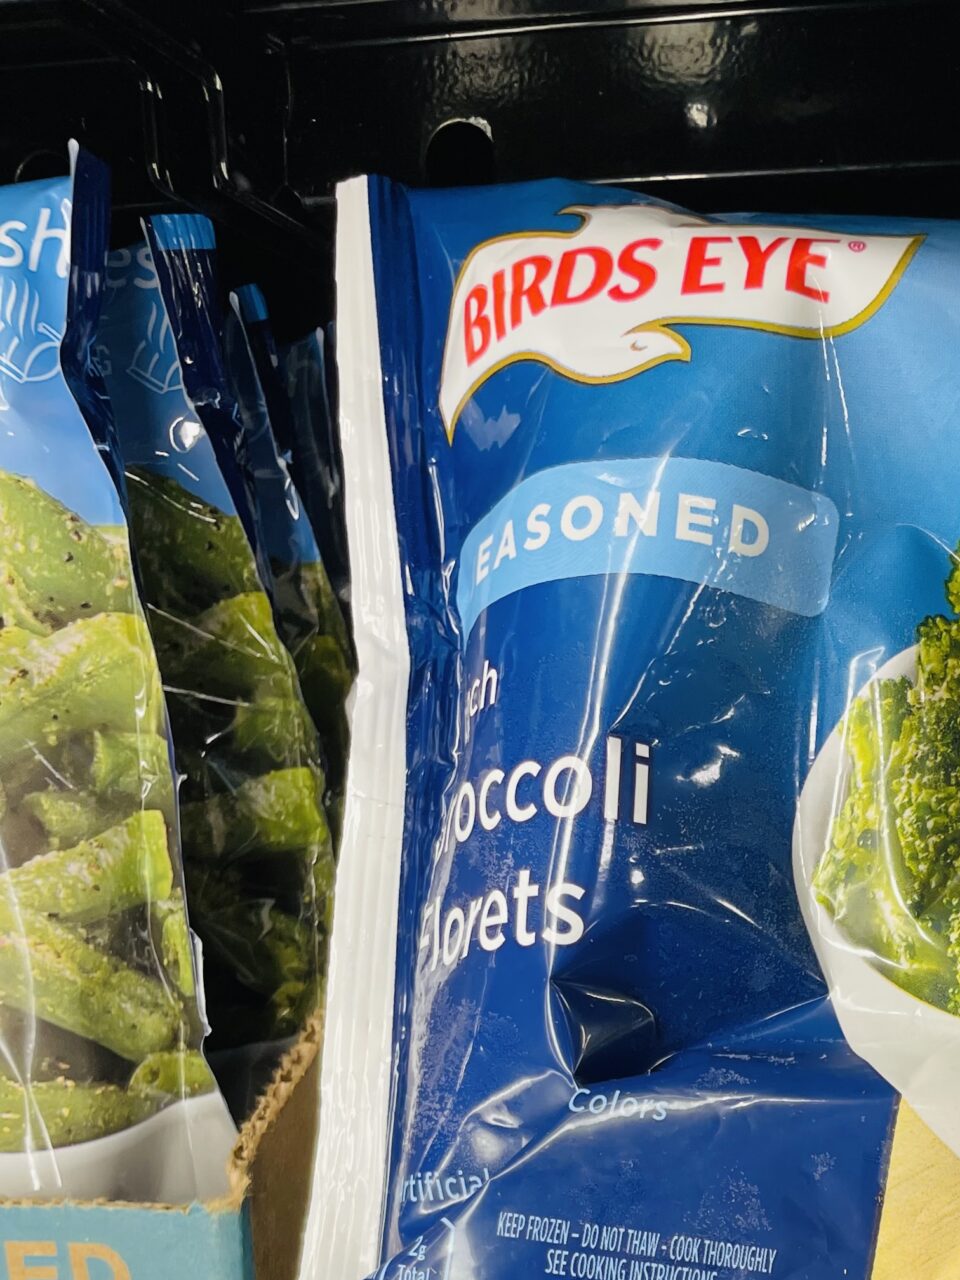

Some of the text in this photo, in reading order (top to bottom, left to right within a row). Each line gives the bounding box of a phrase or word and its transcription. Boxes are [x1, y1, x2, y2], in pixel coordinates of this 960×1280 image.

[462, 238, 663, 367] BIRDS
[475, 491, 771, 586] EASONED
[446, 735, 650, 846] occoli
[568, 1087, 668, 1122] Colors
[408, 1235, 427, 1261] 2g
[497, 1212, 777, 1274] KEEP FROZEN DO NOT THAW COOK THOROUGHLY
[545, 1249, 568, 1275] SEE
